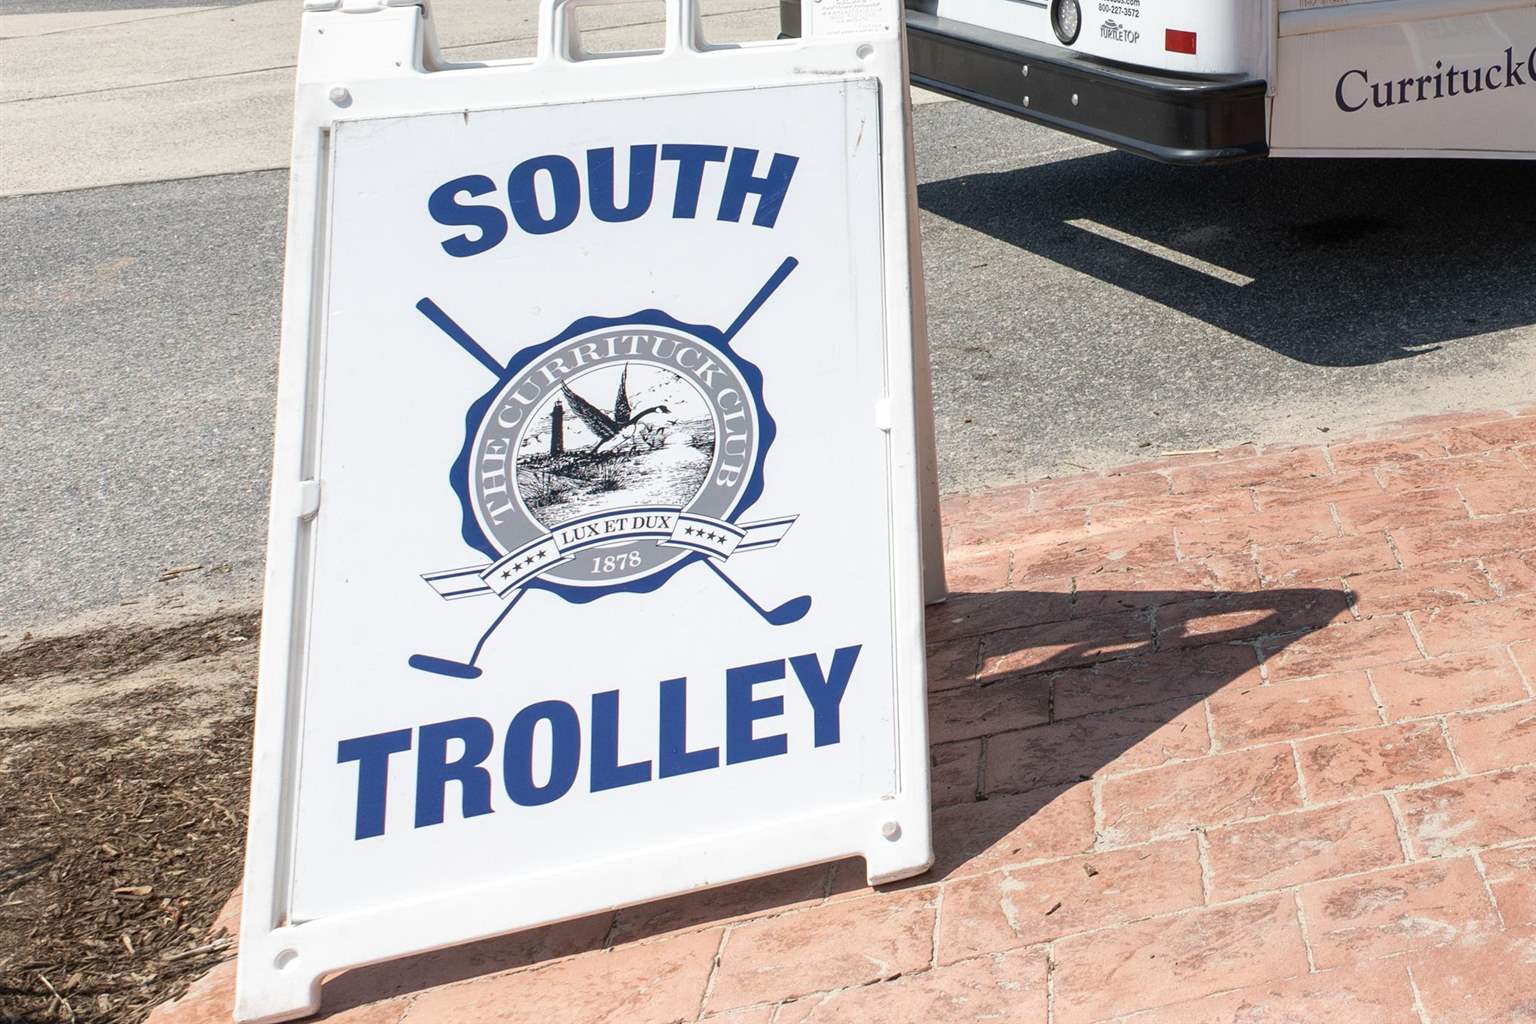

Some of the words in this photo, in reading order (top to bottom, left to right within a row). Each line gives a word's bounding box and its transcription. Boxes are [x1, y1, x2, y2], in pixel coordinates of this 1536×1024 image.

[1098, 3, 1140, 18] 800-227-3572
[428, 143, 800, 258] SOUTH
[481, 437, 515, 525] THE
[498, 335, 722, 429] CURRITUCK
[715, 388, 748, 488] CLUB
[561, 521, 601, 545] LUX
[604, 518, 628, 533] ET
[631, 515, 672, 531] DUX
[591, 551, 643, 574] 1878
[337, 643, 863, 841] TROLLEY
